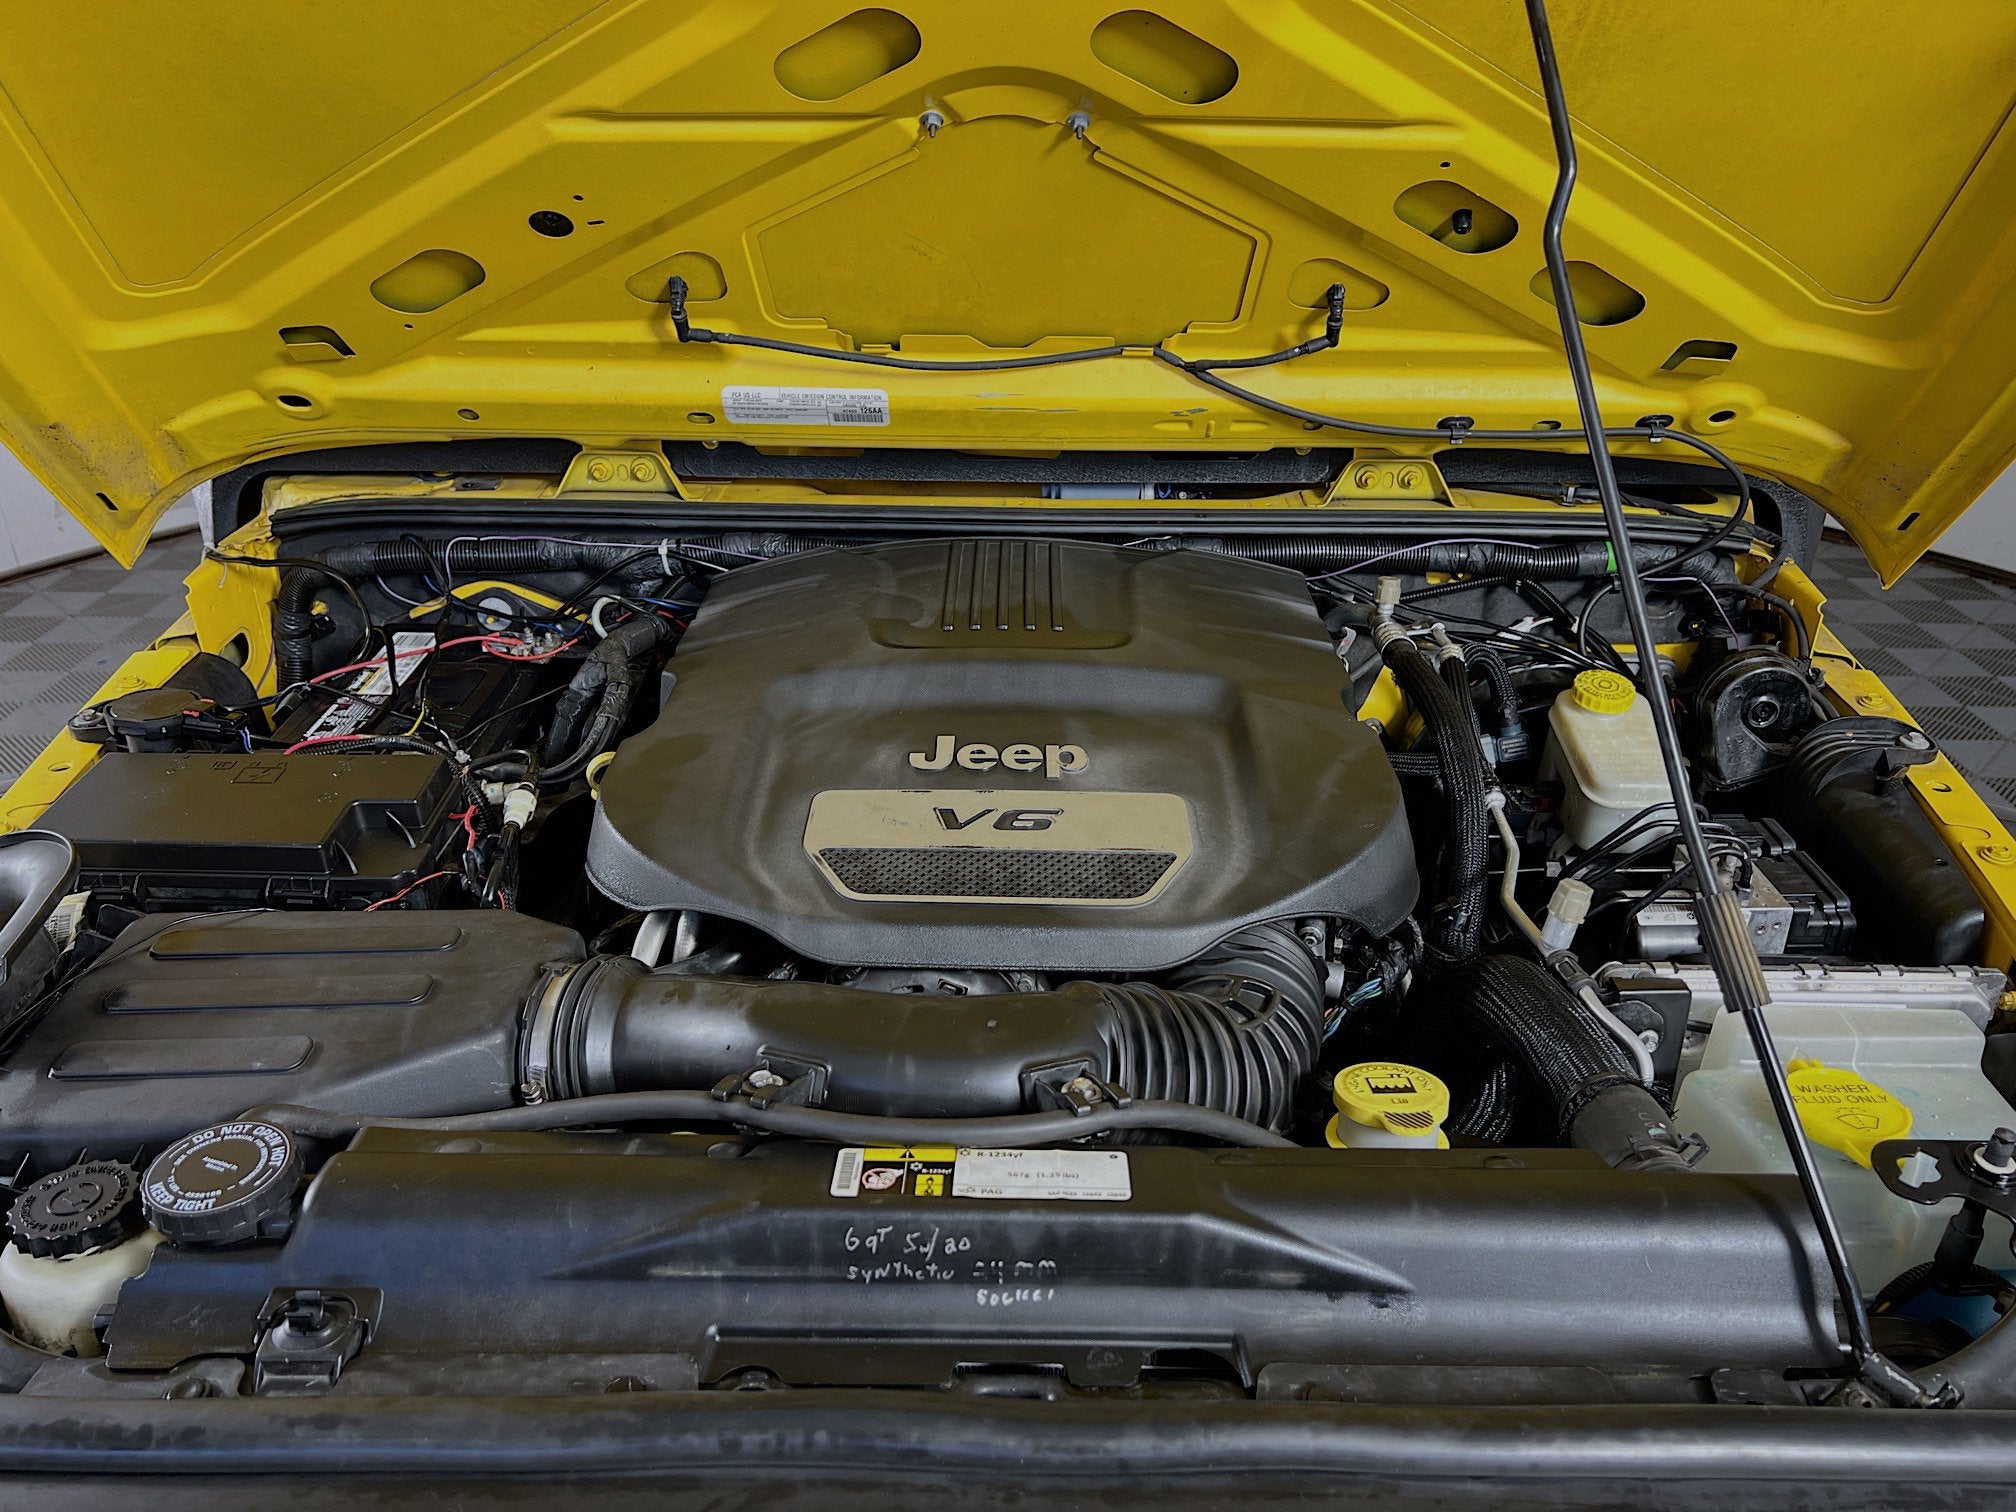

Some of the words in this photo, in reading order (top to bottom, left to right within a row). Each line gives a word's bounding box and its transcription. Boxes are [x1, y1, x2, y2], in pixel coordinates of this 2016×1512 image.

[908, 735, 1090, 780] Jeep
[933, 807, 1065, 831] V6
[1792, 1095, 1842, 1104] FLUID
[1846, 1094, 1889, 1104] ONLY
[1795, 1084, 1872, 1094] WASHER
[191, 1130, 215, 1144] DO
[220, 1124, 253, 1136] NOT
[252, 1125, 284, 1147] OPEN
[268, 1145, 286, 1168] HOT
[222, 1134, 255, 1142] MANUAL
[149, 1181, 175, 1204] KEEP
[172, 1198, 217, 1211] TIGHT
